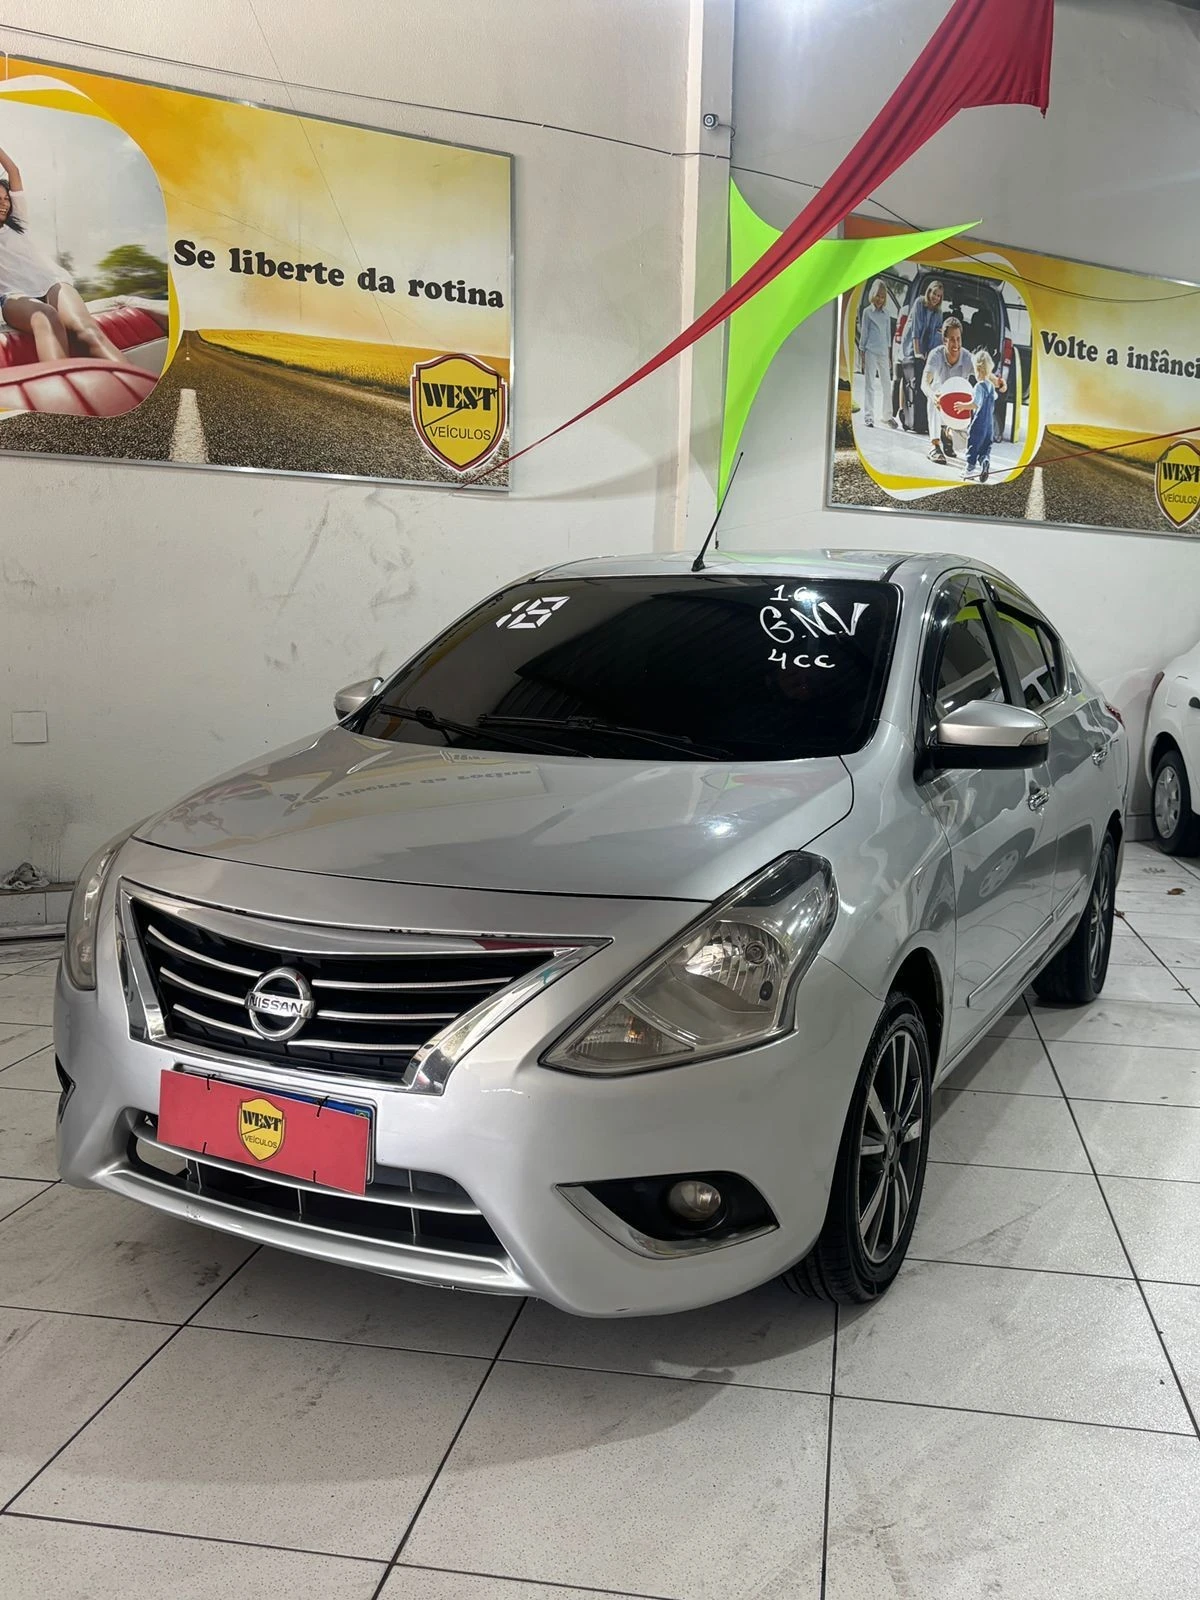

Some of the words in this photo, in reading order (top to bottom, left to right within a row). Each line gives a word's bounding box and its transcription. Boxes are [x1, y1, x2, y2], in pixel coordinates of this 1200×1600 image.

[174, 239, 216, 269] Se
[229, 247, 345, 287] liberte
[357, 267, 396, 294] da
[408, 279, 504, 308] rotina
[1040, 330, 1099, 362] Volte
[1106, 348, 1119, 366] a
[422, 382, 498, 411] WEST
[429, 424, 492, 441] VEÍCULOS
[249, 993, 303, 1014] NISSAN
[242, 1109, 283, 1132] WEST
[244, 1134, 278, 1149] VEÍCULOS
